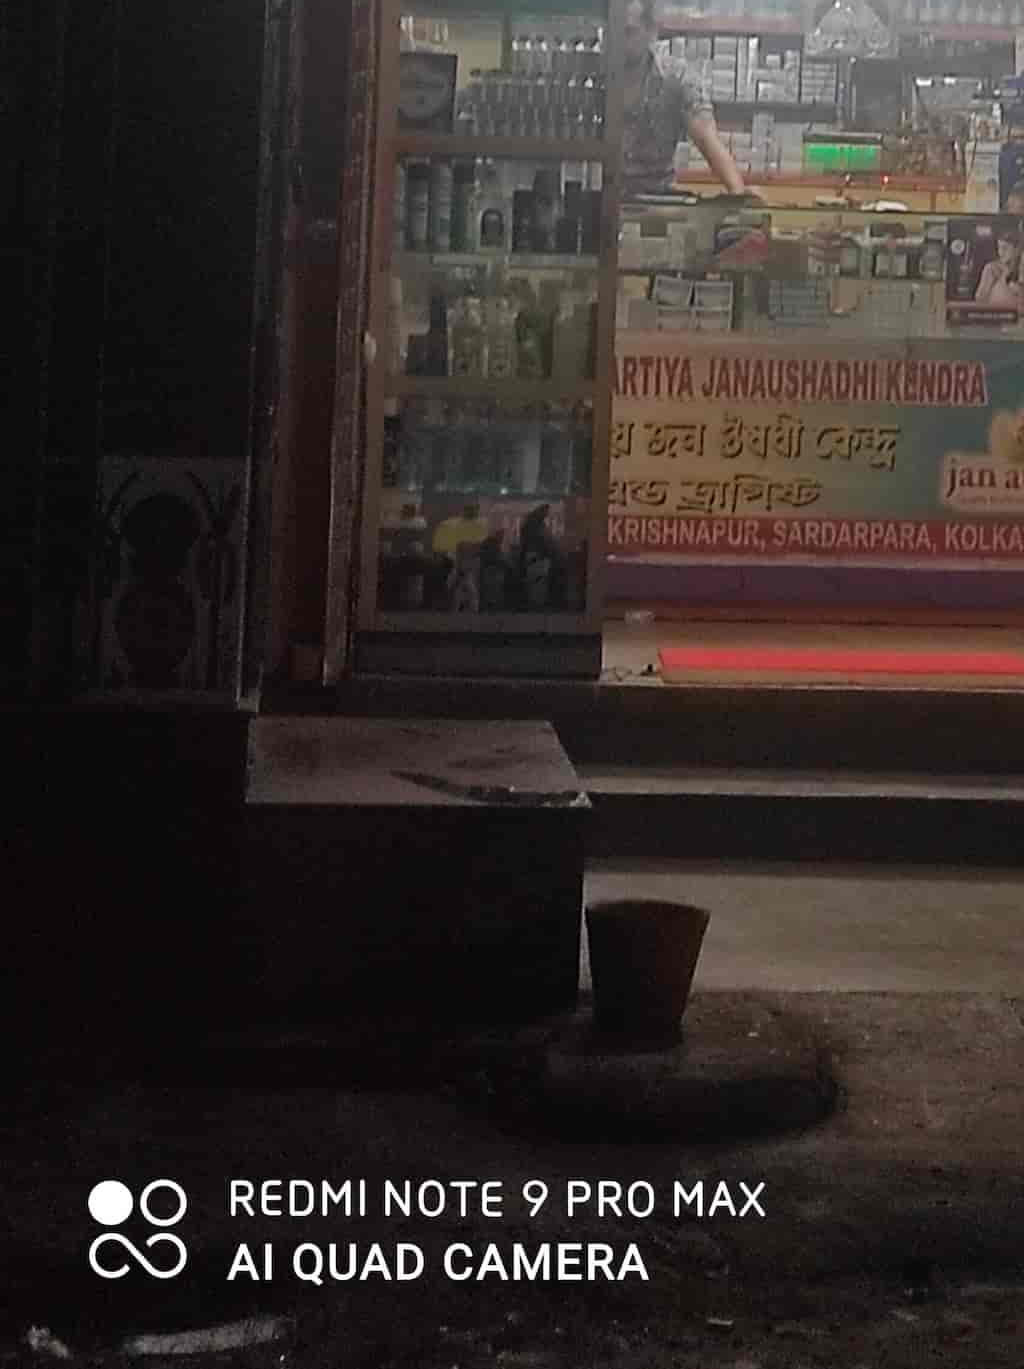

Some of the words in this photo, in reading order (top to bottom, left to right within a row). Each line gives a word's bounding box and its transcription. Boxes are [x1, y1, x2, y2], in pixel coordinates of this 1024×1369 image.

[701, 358, 879, 401] JANAUSHADHI
[886, 360, 987, 406] KENDRA
[945, 457, 997, 498] jan
[608, 519, 766, 551] KRISHNAPUR,
[773, 521, 937, 553] SARDARPARA,
